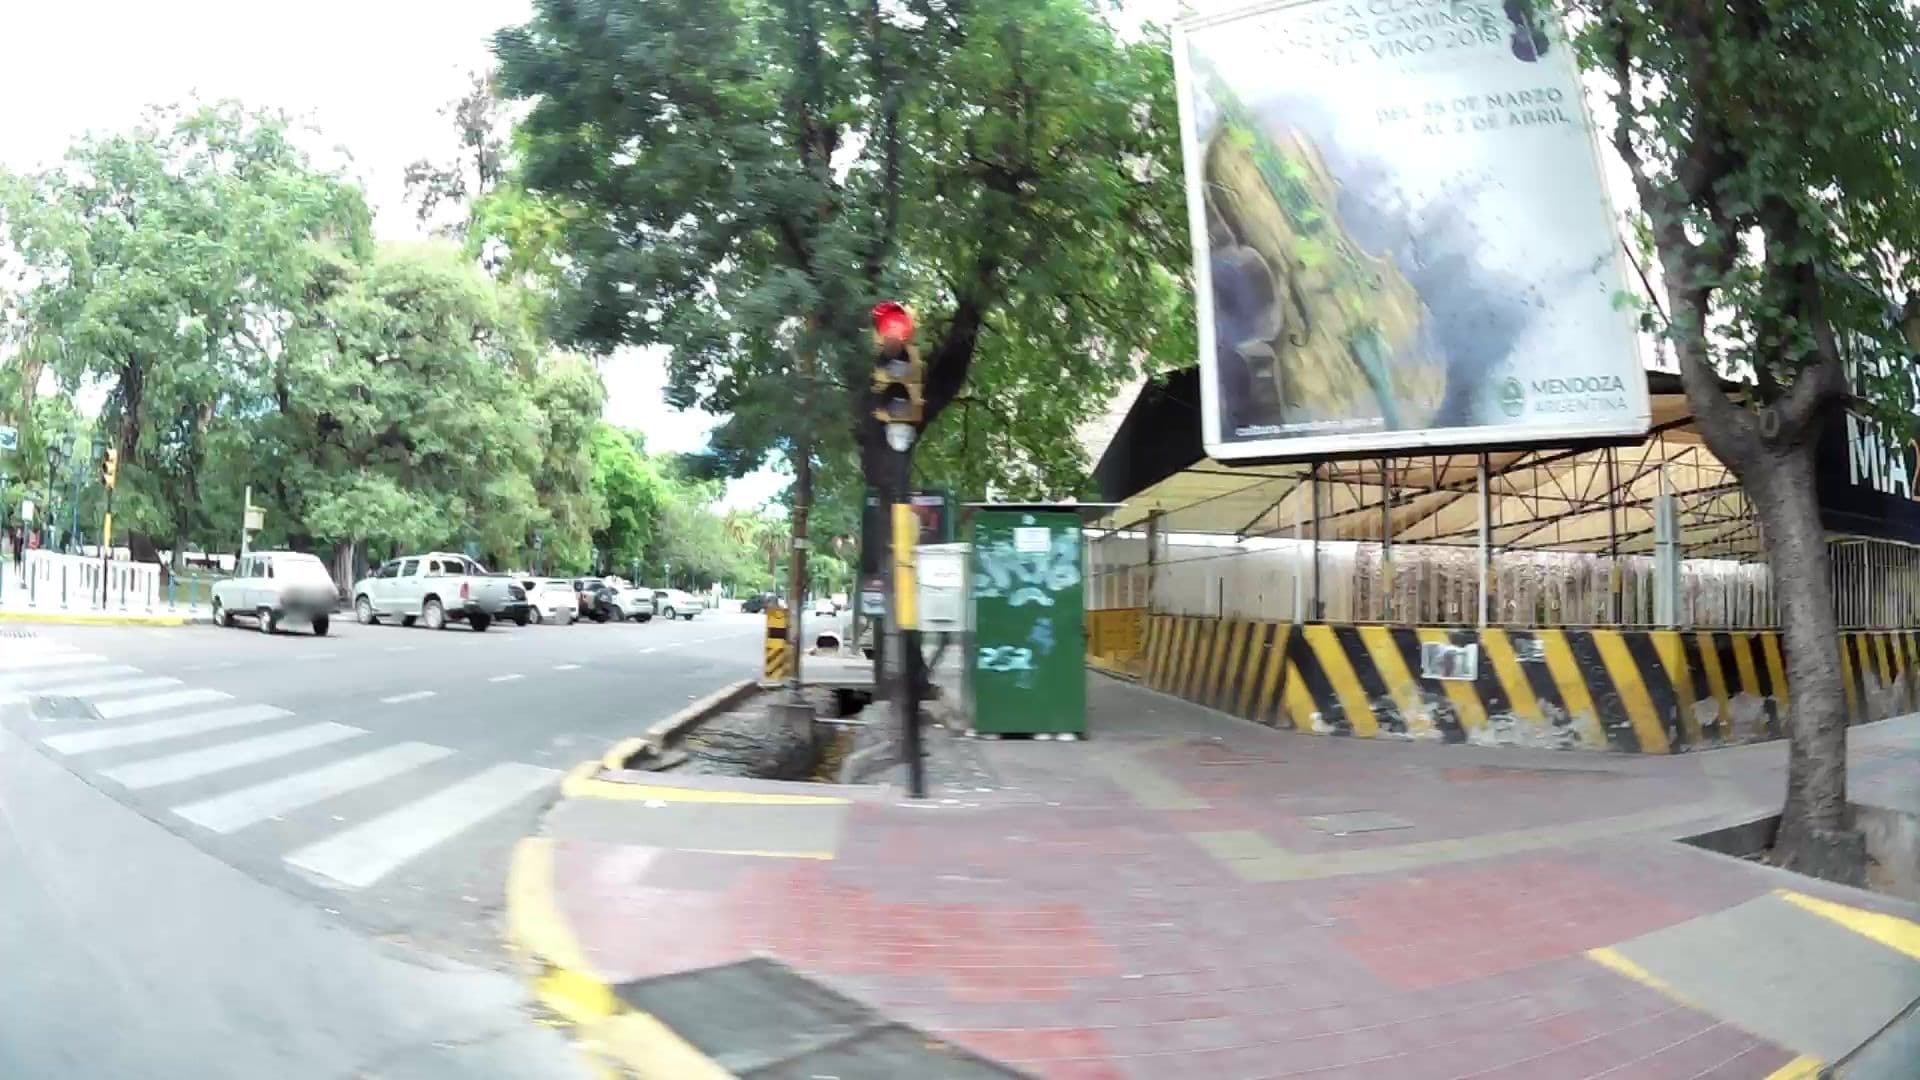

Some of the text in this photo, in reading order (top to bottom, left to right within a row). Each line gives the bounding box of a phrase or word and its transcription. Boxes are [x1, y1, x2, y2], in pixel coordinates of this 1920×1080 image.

[1367, 33, 1432, 60] VINO
[1451, 97, 1478, 114] DE
[1484, 88, 1562, 110] MARZO
[1470, 113, 1497, 131] DE
[1508, 107, 1569, 127] ABRIL
[1531, 376, 1625, 394] MENDOZA
